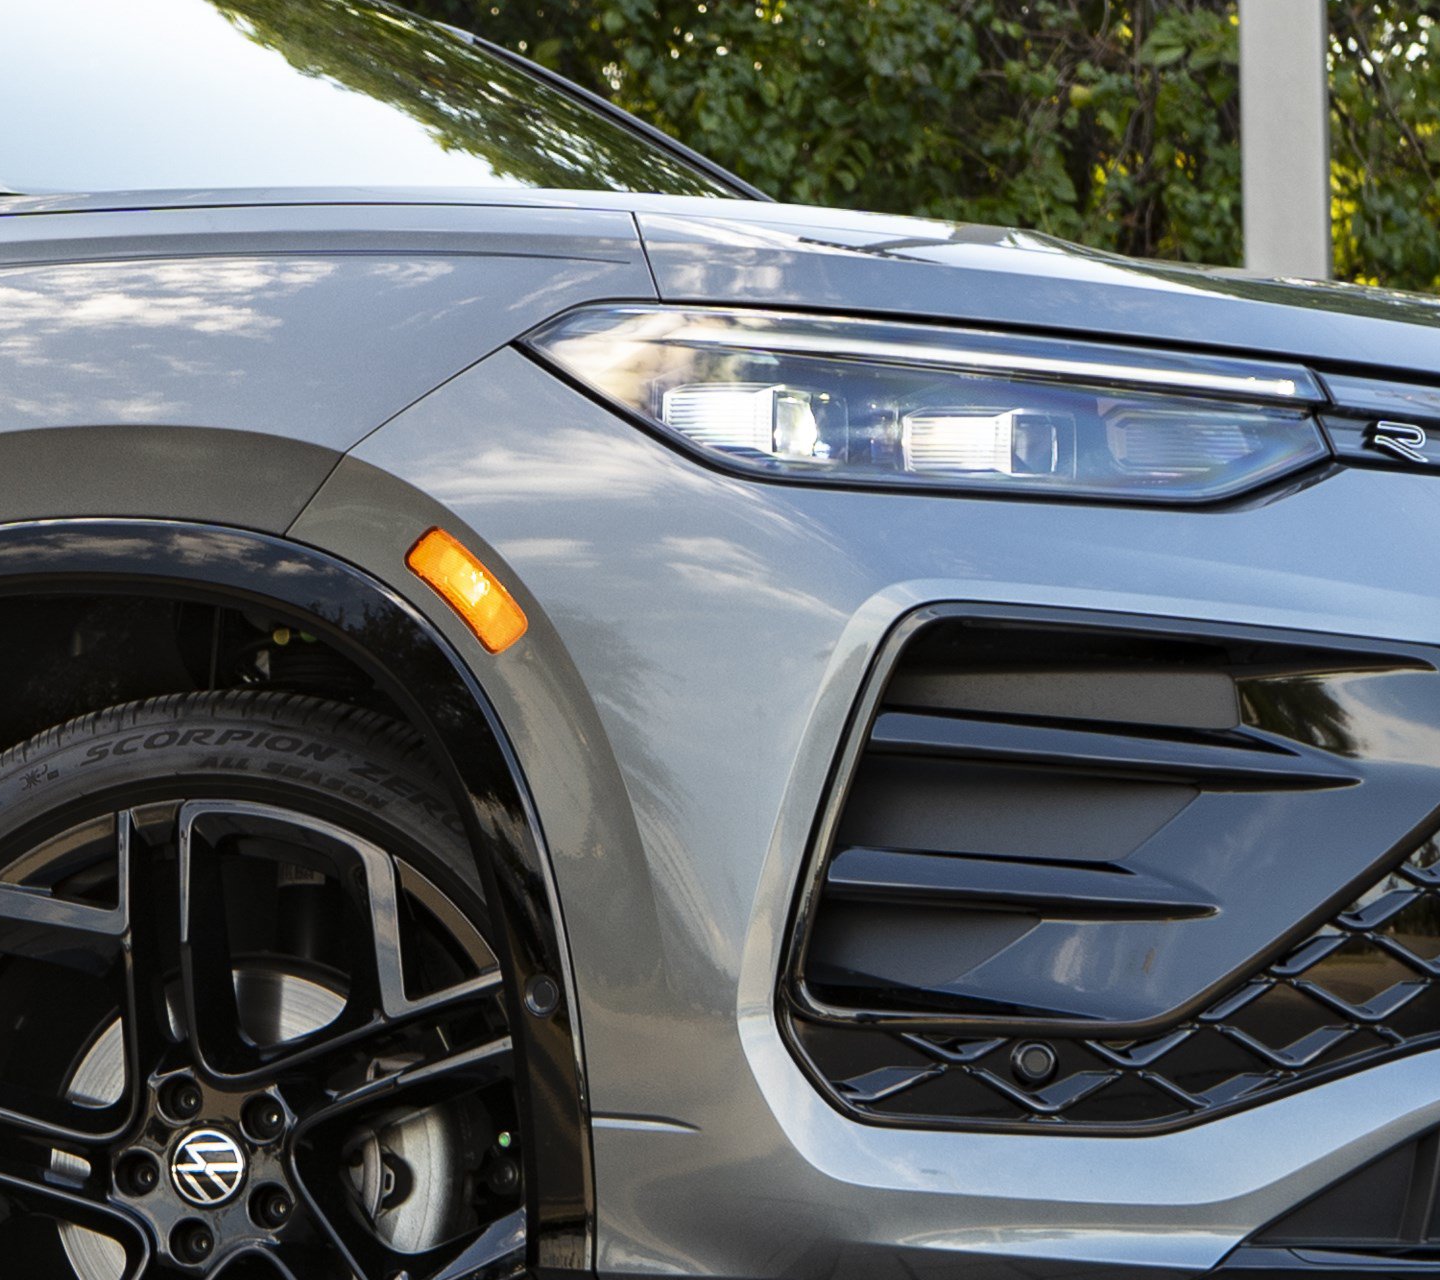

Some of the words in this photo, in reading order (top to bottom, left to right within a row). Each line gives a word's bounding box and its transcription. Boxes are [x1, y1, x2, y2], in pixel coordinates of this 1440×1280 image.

[80, 728, 339, 766] SCORPION
[198, 756, 249, 770] ALL
[261, 761, 390, 810] SEASON
